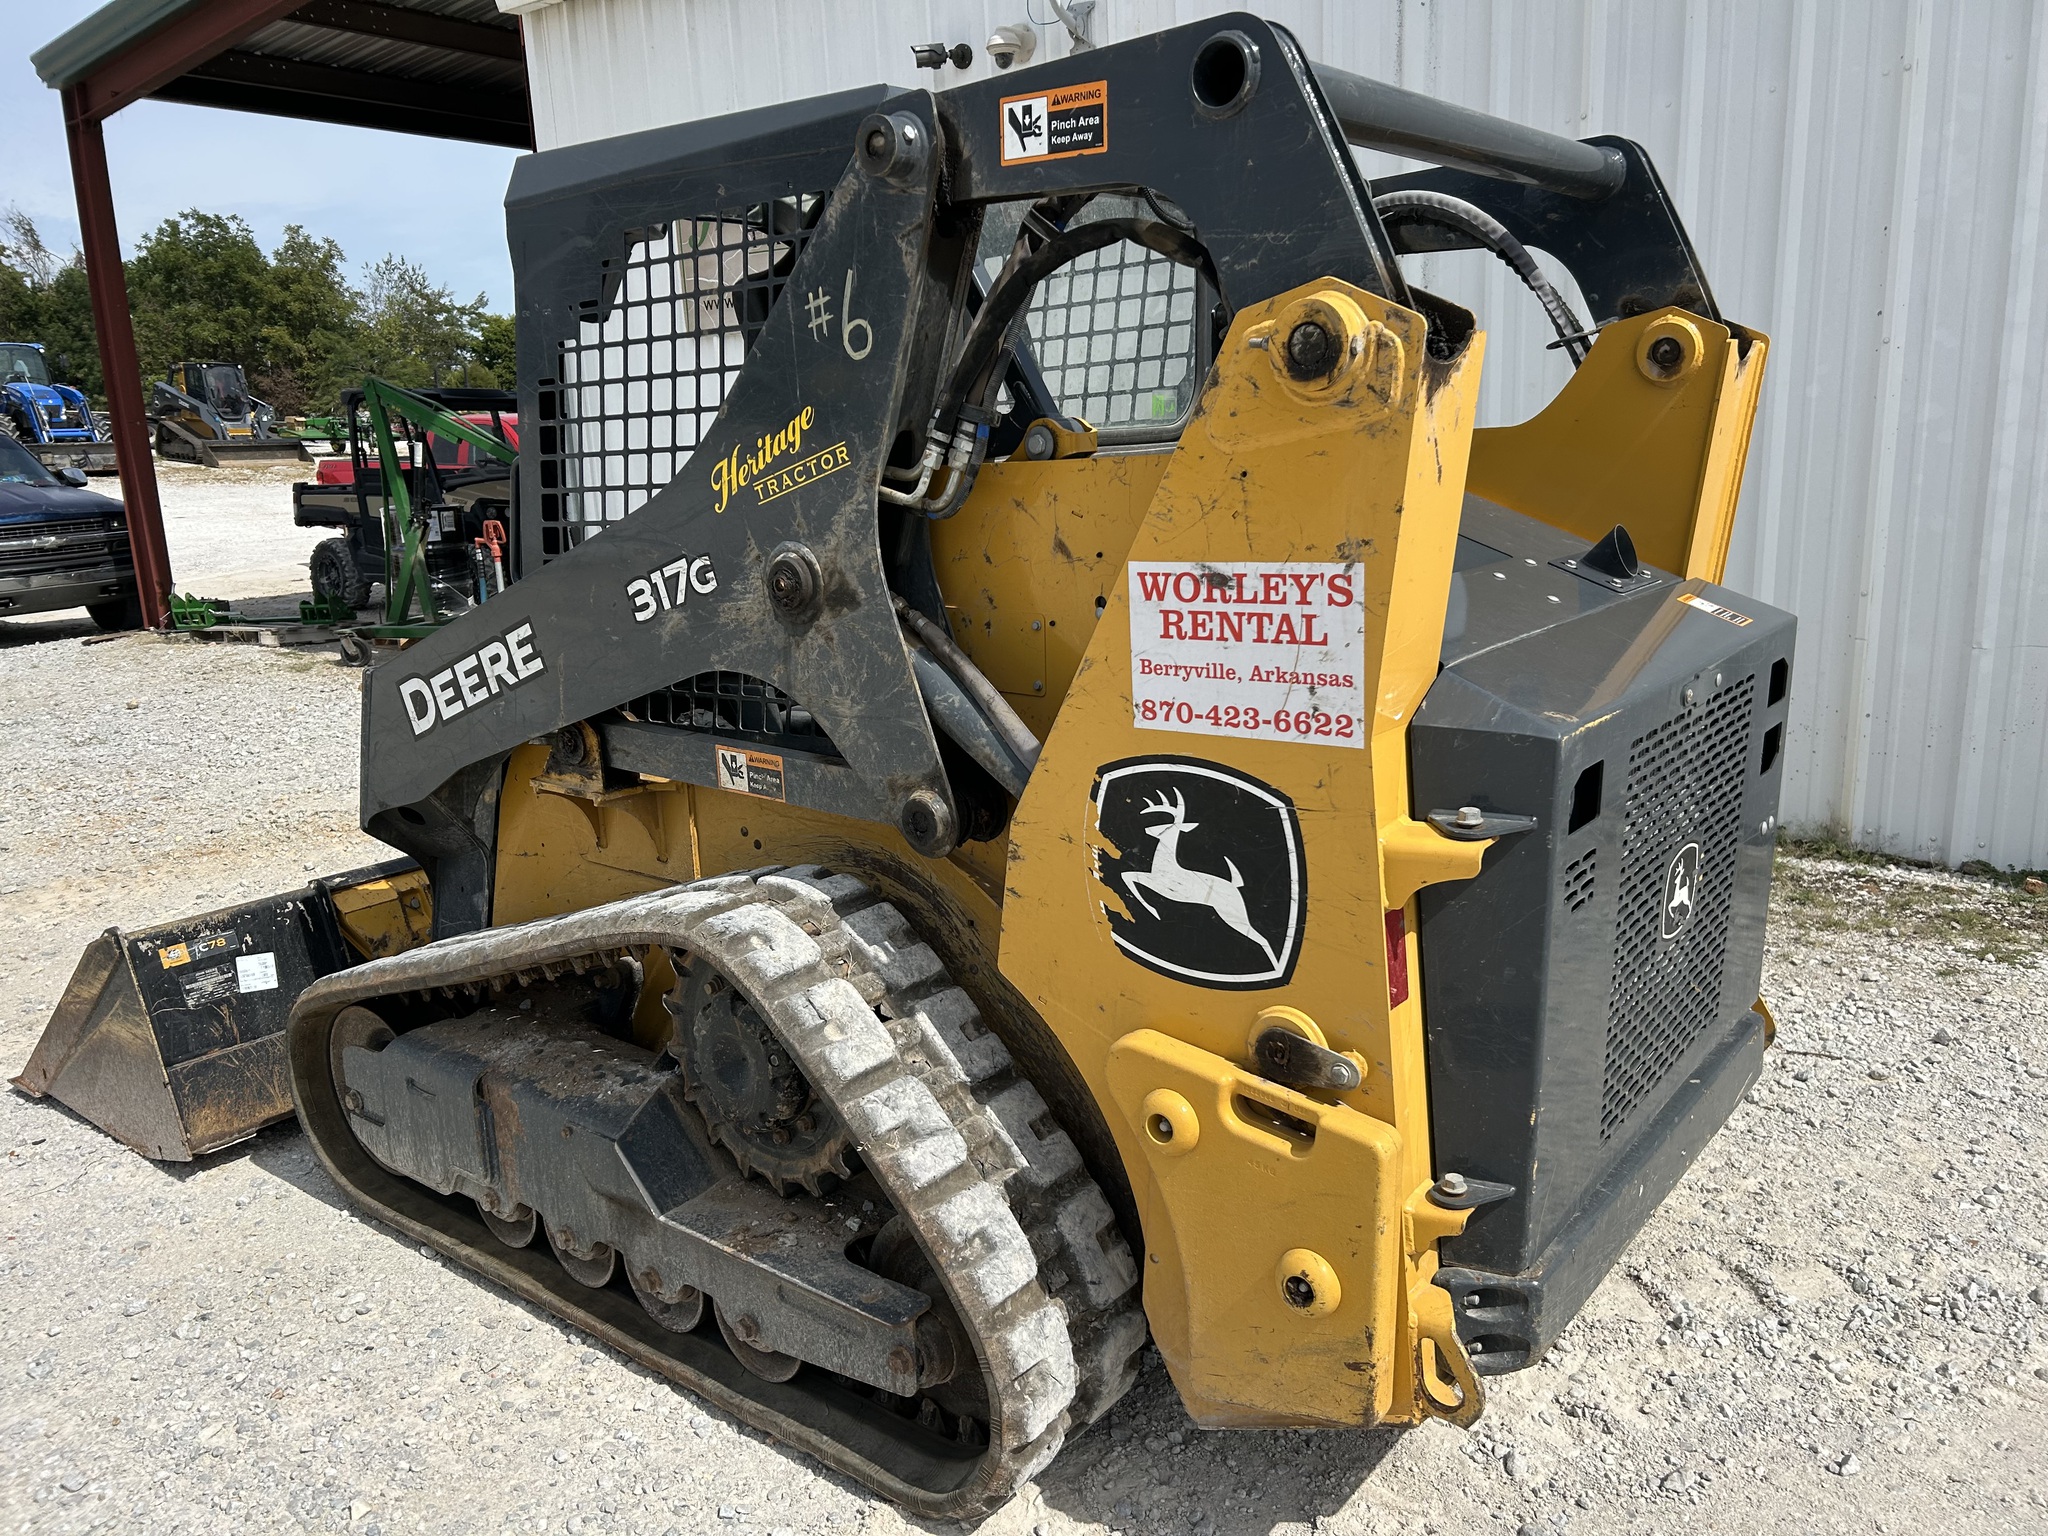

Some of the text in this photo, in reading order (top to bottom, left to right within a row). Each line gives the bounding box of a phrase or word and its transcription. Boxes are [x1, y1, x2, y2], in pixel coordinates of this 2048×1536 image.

[1060, 89, 1101, 104] WARNING
[1051, 115, 1100, 131] Pinch Area
[1051, 132, 1093, 145] Keep Away
[710, 405, 815, 514] Heritage
[754, 446, 850, 500] TRACTOR
[626, 555, 718, 622] 317G
[1137, 571, 1354, 608] WORLEY'S
[1159, 609, 1328, 646] RENTAL
[399, 622, 544, 736] DEERE
[1139, 658, 1354, 688] Berryville, Arkansas
[1141, 699, 1354, 738] 870-423-6622
[753, 757, 780, 767] WARNING
[199, 938, 226, 952] C78
